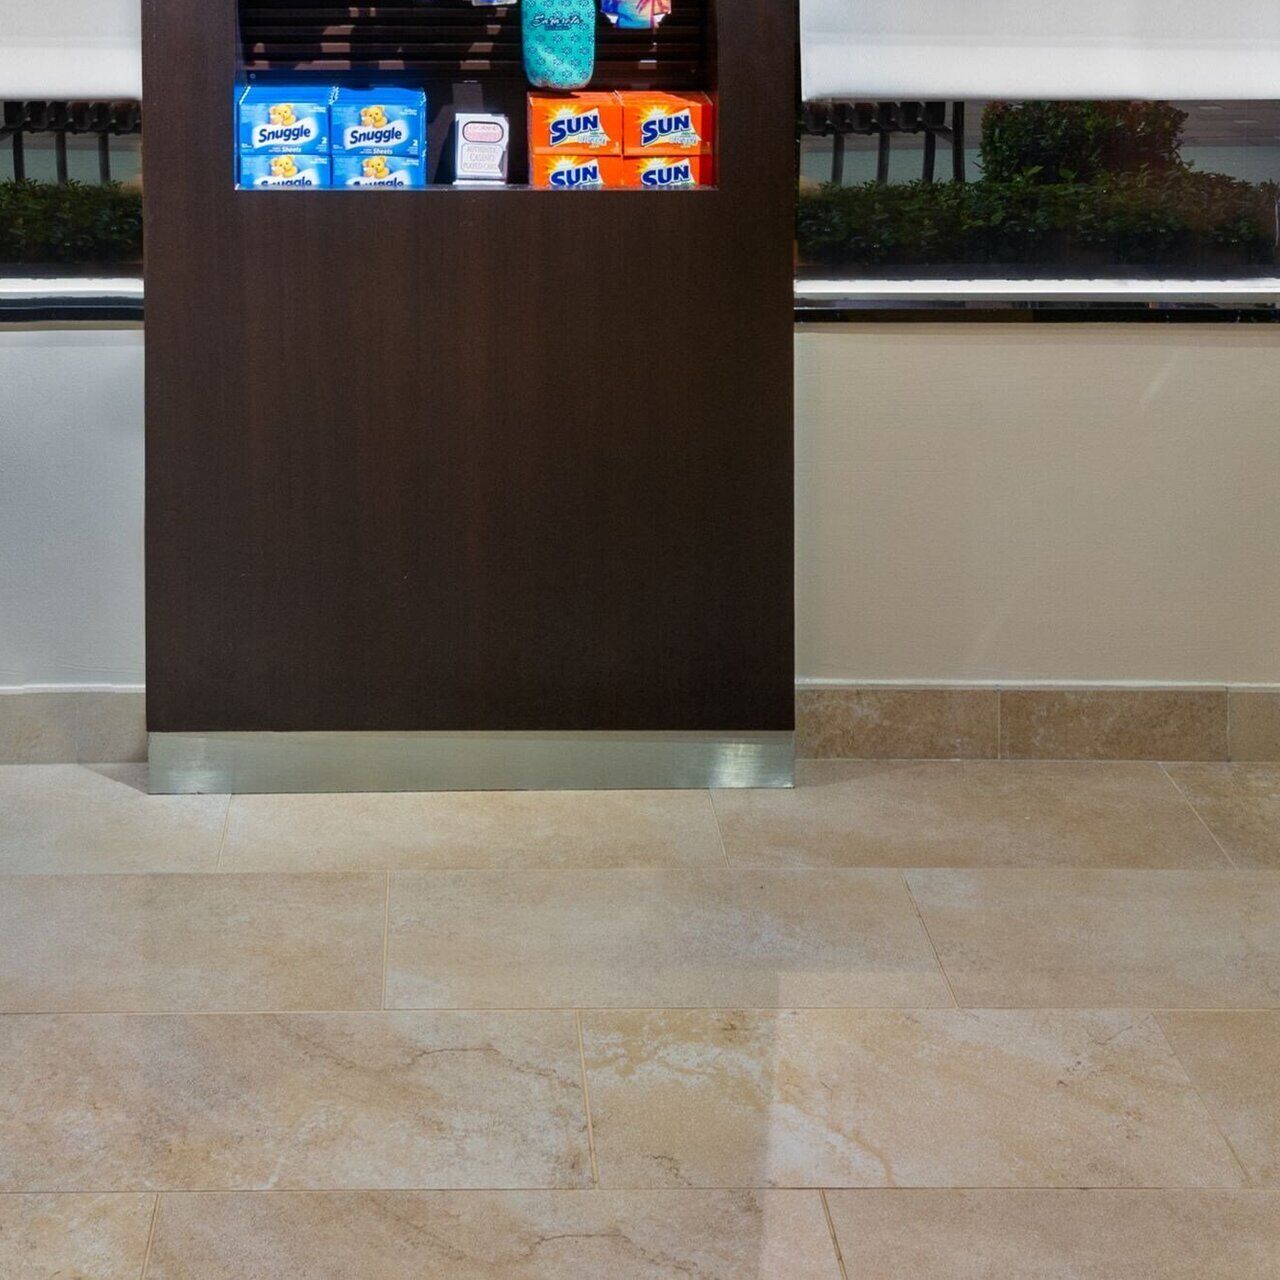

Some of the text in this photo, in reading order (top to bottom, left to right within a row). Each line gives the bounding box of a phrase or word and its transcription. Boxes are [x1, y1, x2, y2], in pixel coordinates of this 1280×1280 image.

[259, 125, 311, 143] Snuggle
[350, 127, 402, 144] Snuggle
[551, 115, 598, 144] SUN
[642, 115, 690, 145] SUN
[550, 165, 599, 185] SUN
[642, 165, 690, 185] SUN
